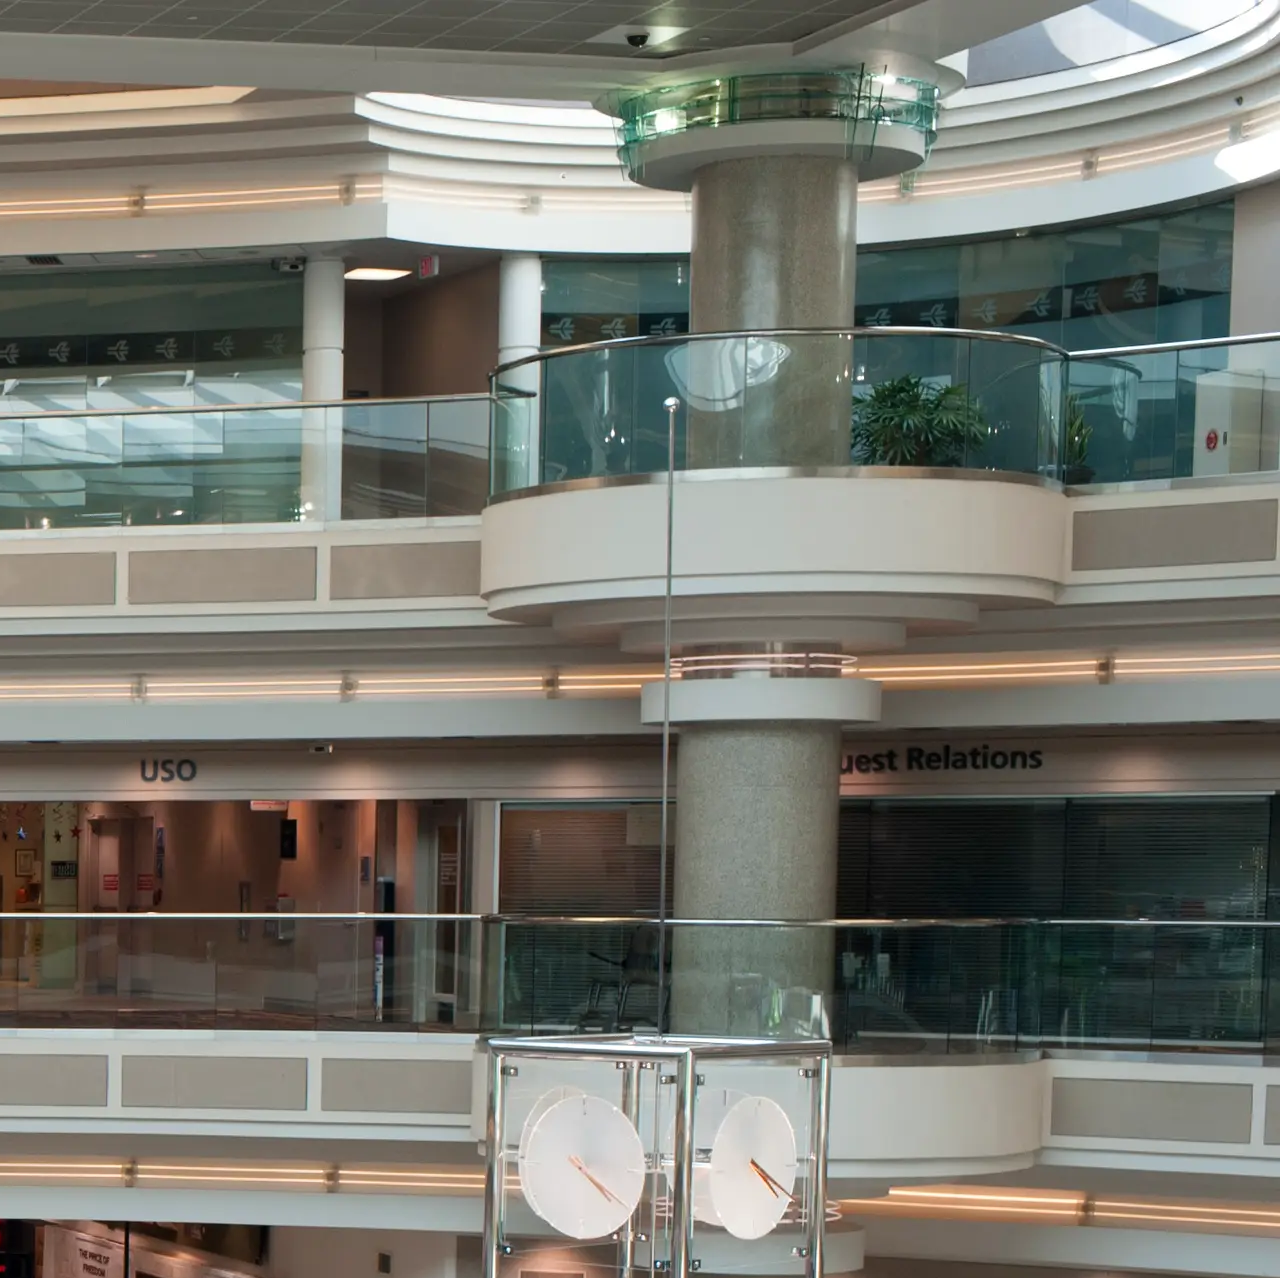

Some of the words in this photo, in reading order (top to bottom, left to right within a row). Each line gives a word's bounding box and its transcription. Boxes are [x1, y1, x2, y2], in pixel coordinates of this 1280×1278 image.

[840, 748, 898, 775] uest
[906, 744, 1044, 771] Relations
[140, 759, 197, 782] USO
[78, 1248, 88, 1260] THE
[88, 1251, 103, 1265] PRICE
[82, 1263, 106, 1278] FREEDOM
